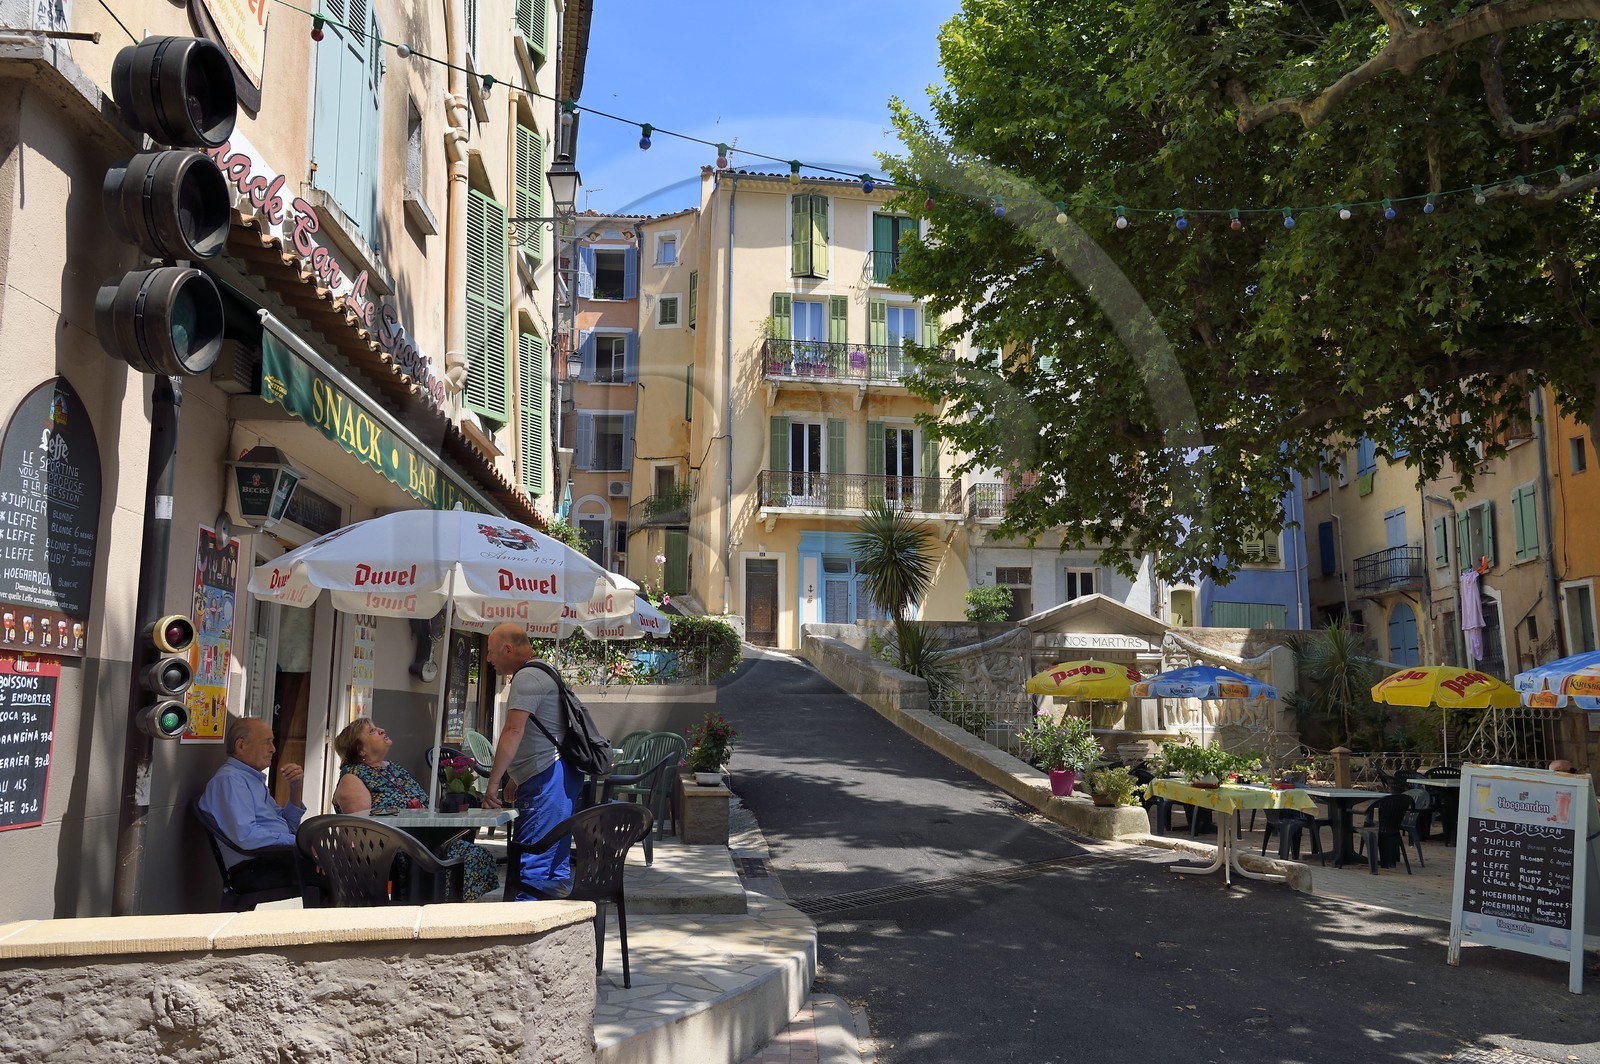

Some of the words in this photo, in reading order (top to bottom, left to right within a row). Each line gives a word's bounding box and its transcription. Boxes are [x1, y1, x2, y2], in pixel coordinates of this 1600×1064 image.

[292, 197, 343, 290] Bar
[346, 269, 377, 328] Le
[378, 304, 445, 411] Sporting
[39, 428, 69, 463] Leffe
[312, 377, 383, 467] SNACK
[409, 452, 437, 505] BAR
[442, 479, 455, 511] LE
[22, 450, 34, 465] LE
[40, 456, 80, 478] SPORTING
[18, 467, 39, 479] VOUS
[48, 473, 85, 494] PROPOSE
[22, 479, 28, 490] A
[31, 481, 40, 491] LA
[43, 484, 80, 503] PRESSION
[8, 493, 48, 517] JUPILER
[52, 510, 74, 523] BLONDE
[7, 511, 38, 530] LEFFE
[51, 522, 73, 536] BLONDE
[74, 526, 79, 538] 6
[6, 528, 36, 545] LEFFE
[45, 537, 71, 552] BLONDE
[73, 543, 78, 555] 9
[5, 547, 34, 562] LEFFE
[44, 551, 67, 565] RUBY
[71, 556, 76, 567] 5
[480, 550, 528, 563] Anno
[534, 557, 564, 566] 1871
[4, 567, 53, 587] HOEGAARDEN
[57, 577, 79, 589] BLANCHE
[355, 563, 417, 586] Duvel
[497, 568, 558, 595] Duvel
[8, 592, 22, 601] quelle
[22, 594, 33, 603] Leffe
[15, 582, 37, 594] Demandez
[42, 588, 52, 597] votre
[1063, 636, 1088, 647] NOS
[1093, 637, 1143, 648] MARTYRS
[11, 693, 52, 704] EMPORTER
[0, 711, 19, 722] COCA
[0, 729, 39, 744] RANGINA
[1497, 796, 1551, 814] Hoegaarden
[1479, 820, 1487, 829] A
[1494, 821, 1507, 830] LA
[1514, 823, 1563, 835] PRESSION
[1484, 837, 1522, 849] JUPILER
[1483, 848, 1511, 859] LEFFE
[1520, 854, 1545, 863] BLONDE
[1483, 861, 1510, 871] LEFFE
[1519, 867, 1542, 876] BLONDE
[1483, 870, 1510, 880] LEFFE
[1519, 875, 1542, 885] RUBY
[1548, 879, 1553, 887] 5
[1481, 890, 1532, 904] HOEGAARDEN
[1481, 900, 1531, 914] HOEGAARDEN
[1496, 918, 1535, 934] Hoegaarden
